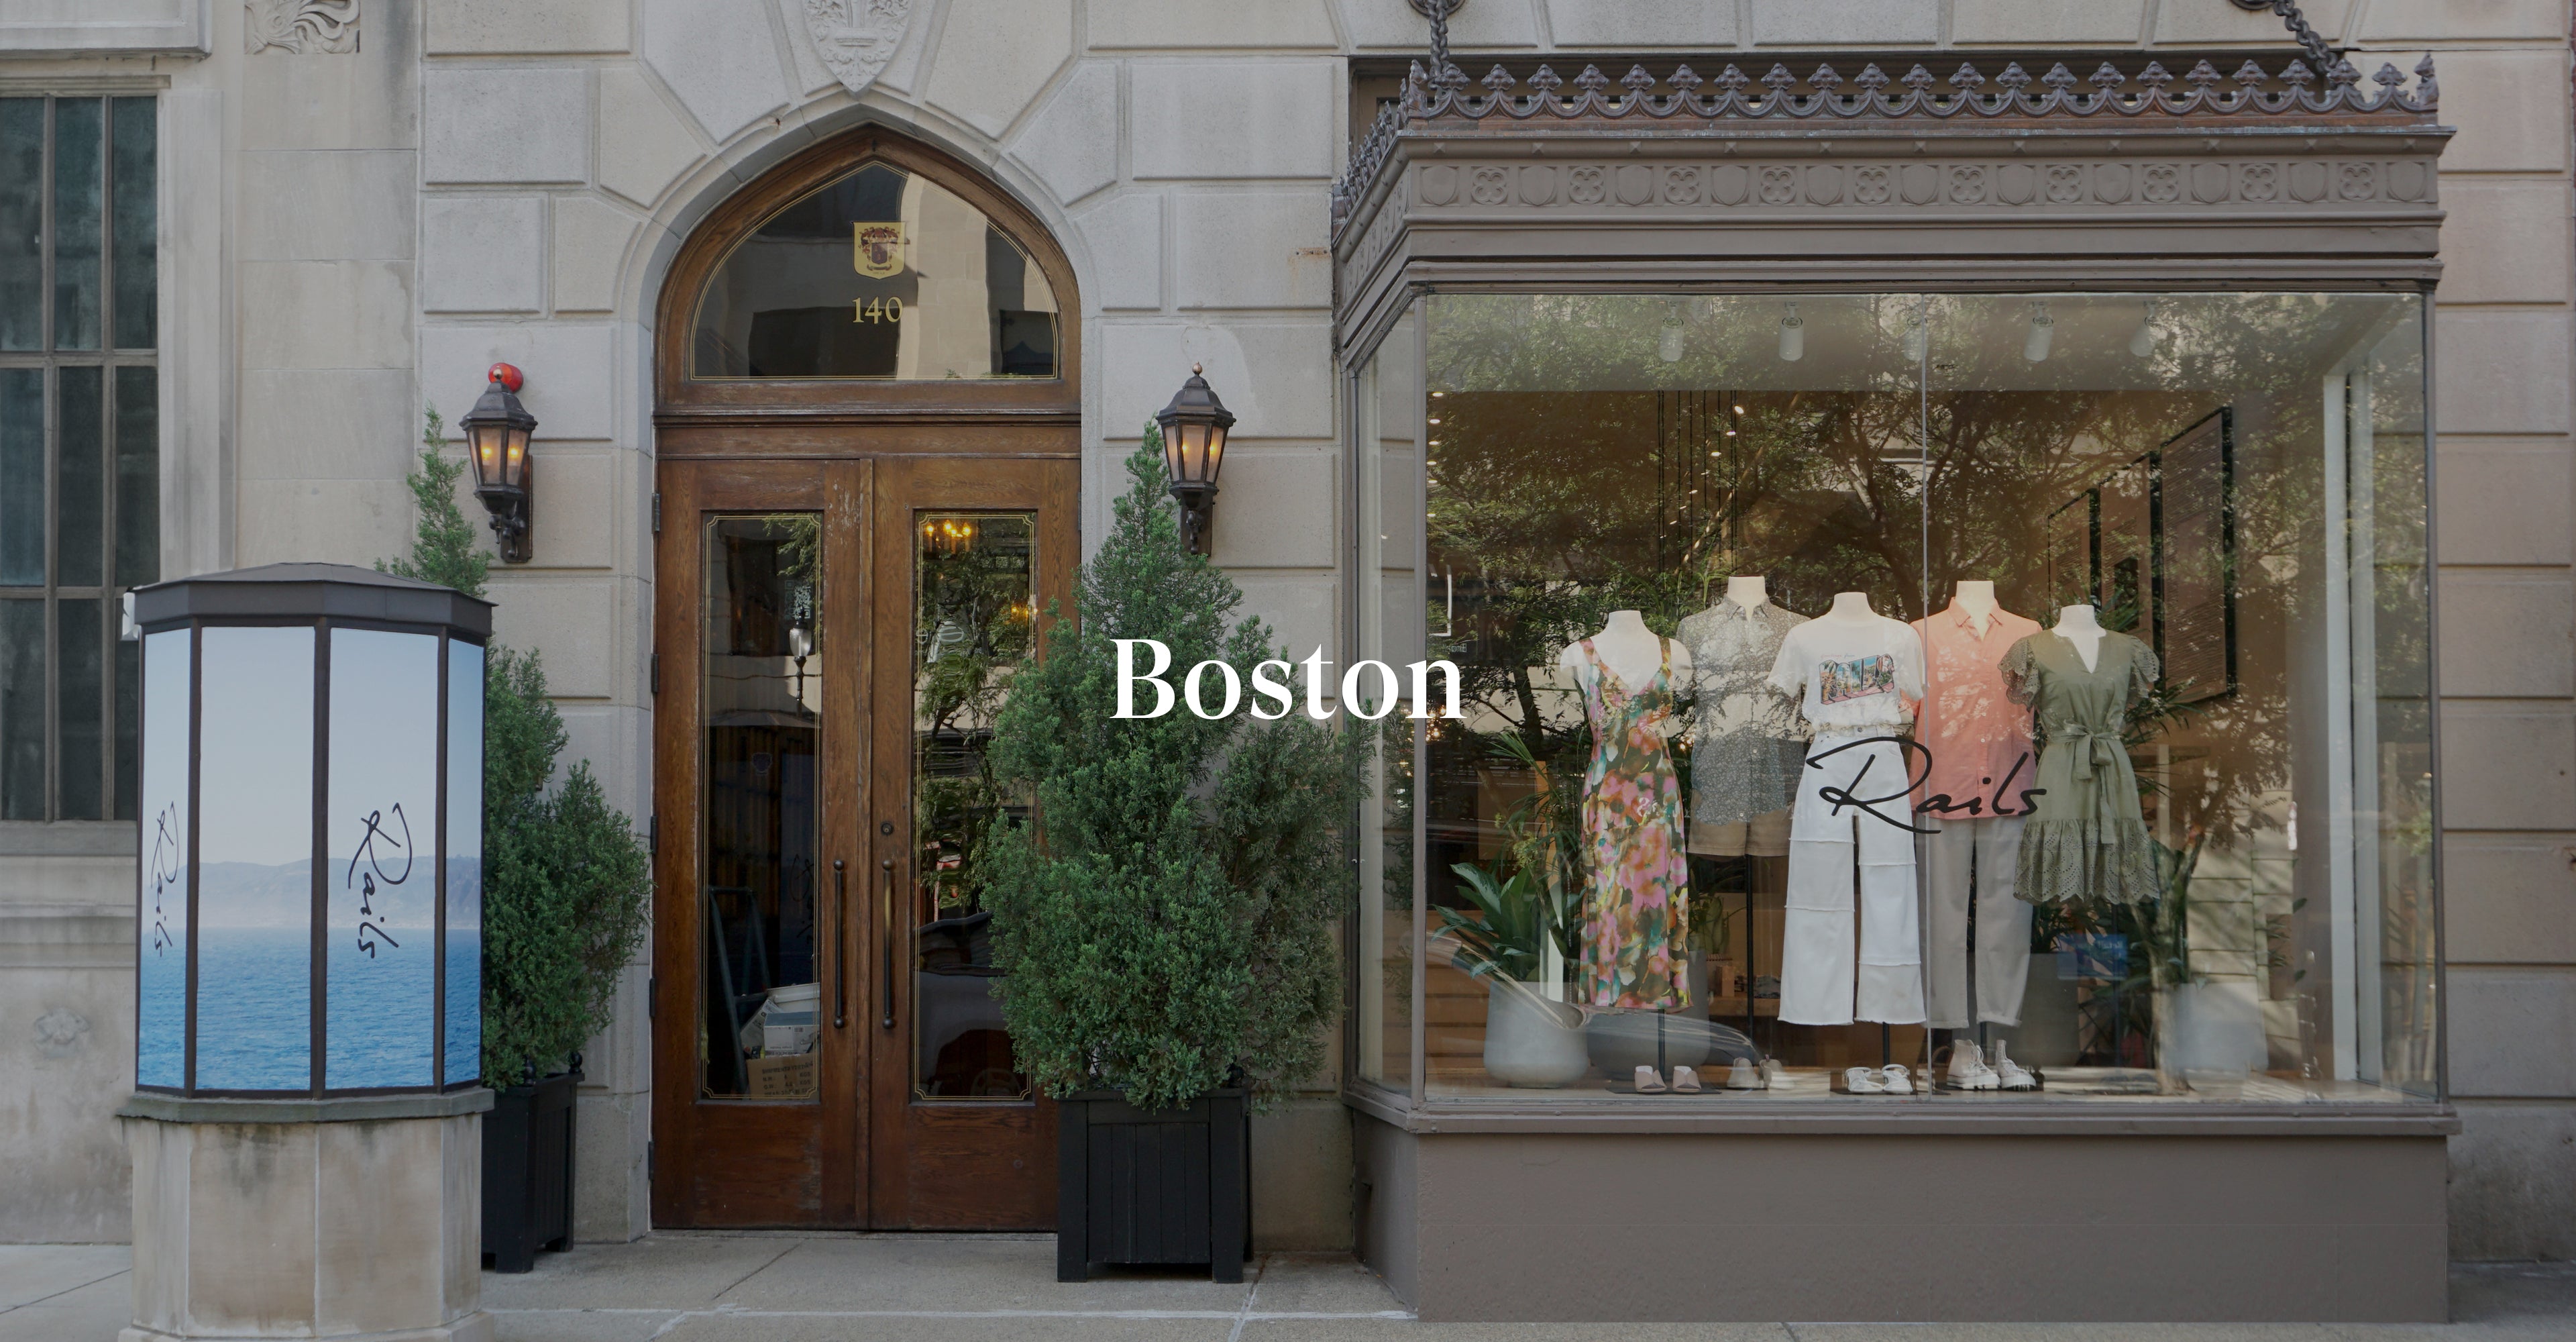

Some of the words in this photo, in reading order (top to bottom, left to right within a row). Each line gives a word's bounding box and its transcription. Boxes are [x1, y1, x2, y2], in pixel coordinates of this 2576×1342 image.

[852, 296, 904, 324] 140
[1806, 736, 2047, 834] Rails
[151, 801, 179, 957] Rails
[348, 803, 412, 959] Rails
